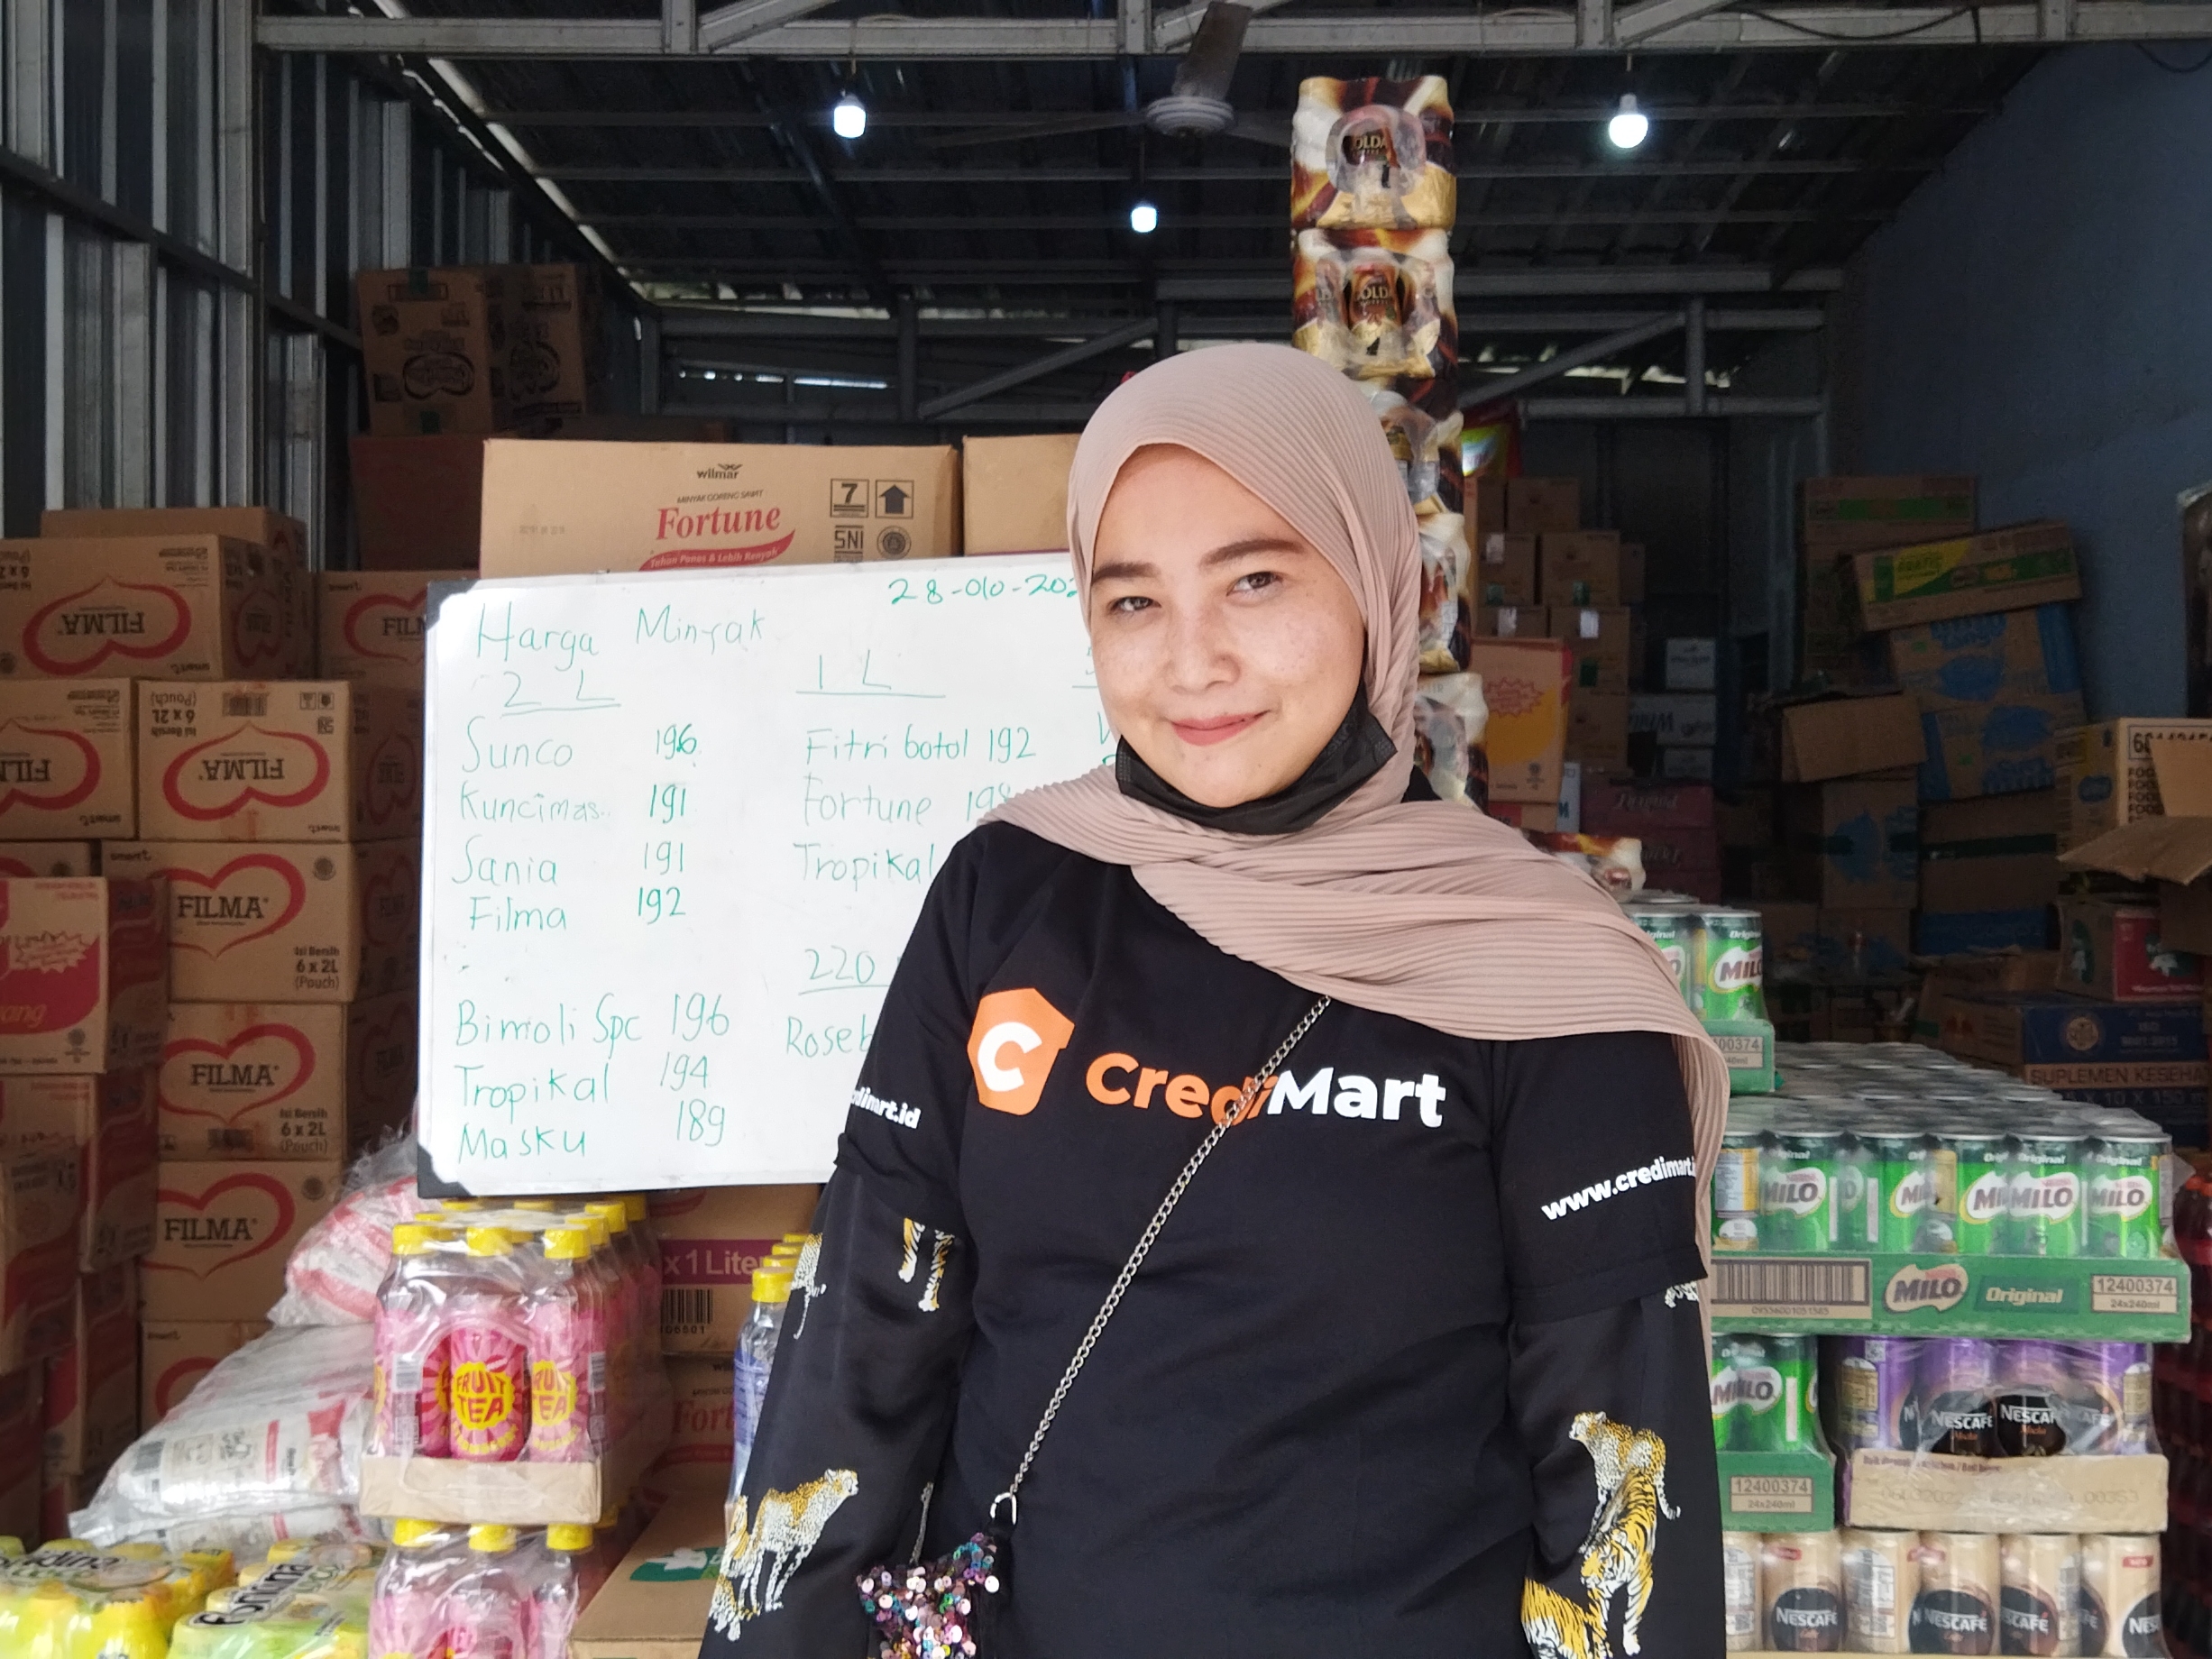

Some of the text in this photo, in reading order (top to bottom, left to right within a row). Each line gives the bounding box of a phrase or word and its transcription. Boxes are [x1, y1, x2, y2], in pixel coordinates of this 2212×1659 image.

[696, 466, 739, 480] wilmar
[841, 482, 858, 504] 7
[656, 506, 781, 541] Fortune
[834, 530, 864, 549] SNI
[61, 613, 146, 636] FILMA
[477, 601, 600, 672] Harga
[503, 669, 616, 708] 2 L
[462, 715, 698, 773] Sunco 196
[806, 728, 889, 765] Fitri
[988, 726, 1037, 764] 192
[202, 759, 285, 781] FILMA
[650, 784, 687, 825] 191
[803, 772, 932, 828] Fortune
[451, 834, 684, 887] Sania 191
[793, 842, 934, 893] Tropikal
[178, 895, 264, 920] FILMA
[469, 886, 686, 932] Filma 192
[296, 959, 339, 973] 6 x 2L
[804, 944, 876, 985] 220
[294, 975, 340, 990] (Pouch)
[592, 991, 643, 1060] Spc
[672, 992, 730, 1042] 196
[190, 1064, 275, 1086] FILMA
[454, 1050, 709, 1125] Tropikal 194
[2030, 1067, 2128, 1085] SUPLEMEN
[1085, 1051, 1446, 1129] CrediMart
[280, 1123, 326, 1137] 6 x 2L
[457, 1098, 726, 1164] Masku 189
[2011, 1187, 2073, 1209] MILO
[164, 1218, 254, 1242] FILMA
[685, 1249, 699, 1276] 1
[1892, 1277, 2174, 1306] MILO Original 12400374
[455, 1370, 507, 1395] FRUIT
[457, 1395, 505, 1424] TEA
[1734, 1479, 1808, 1493] 12400374
